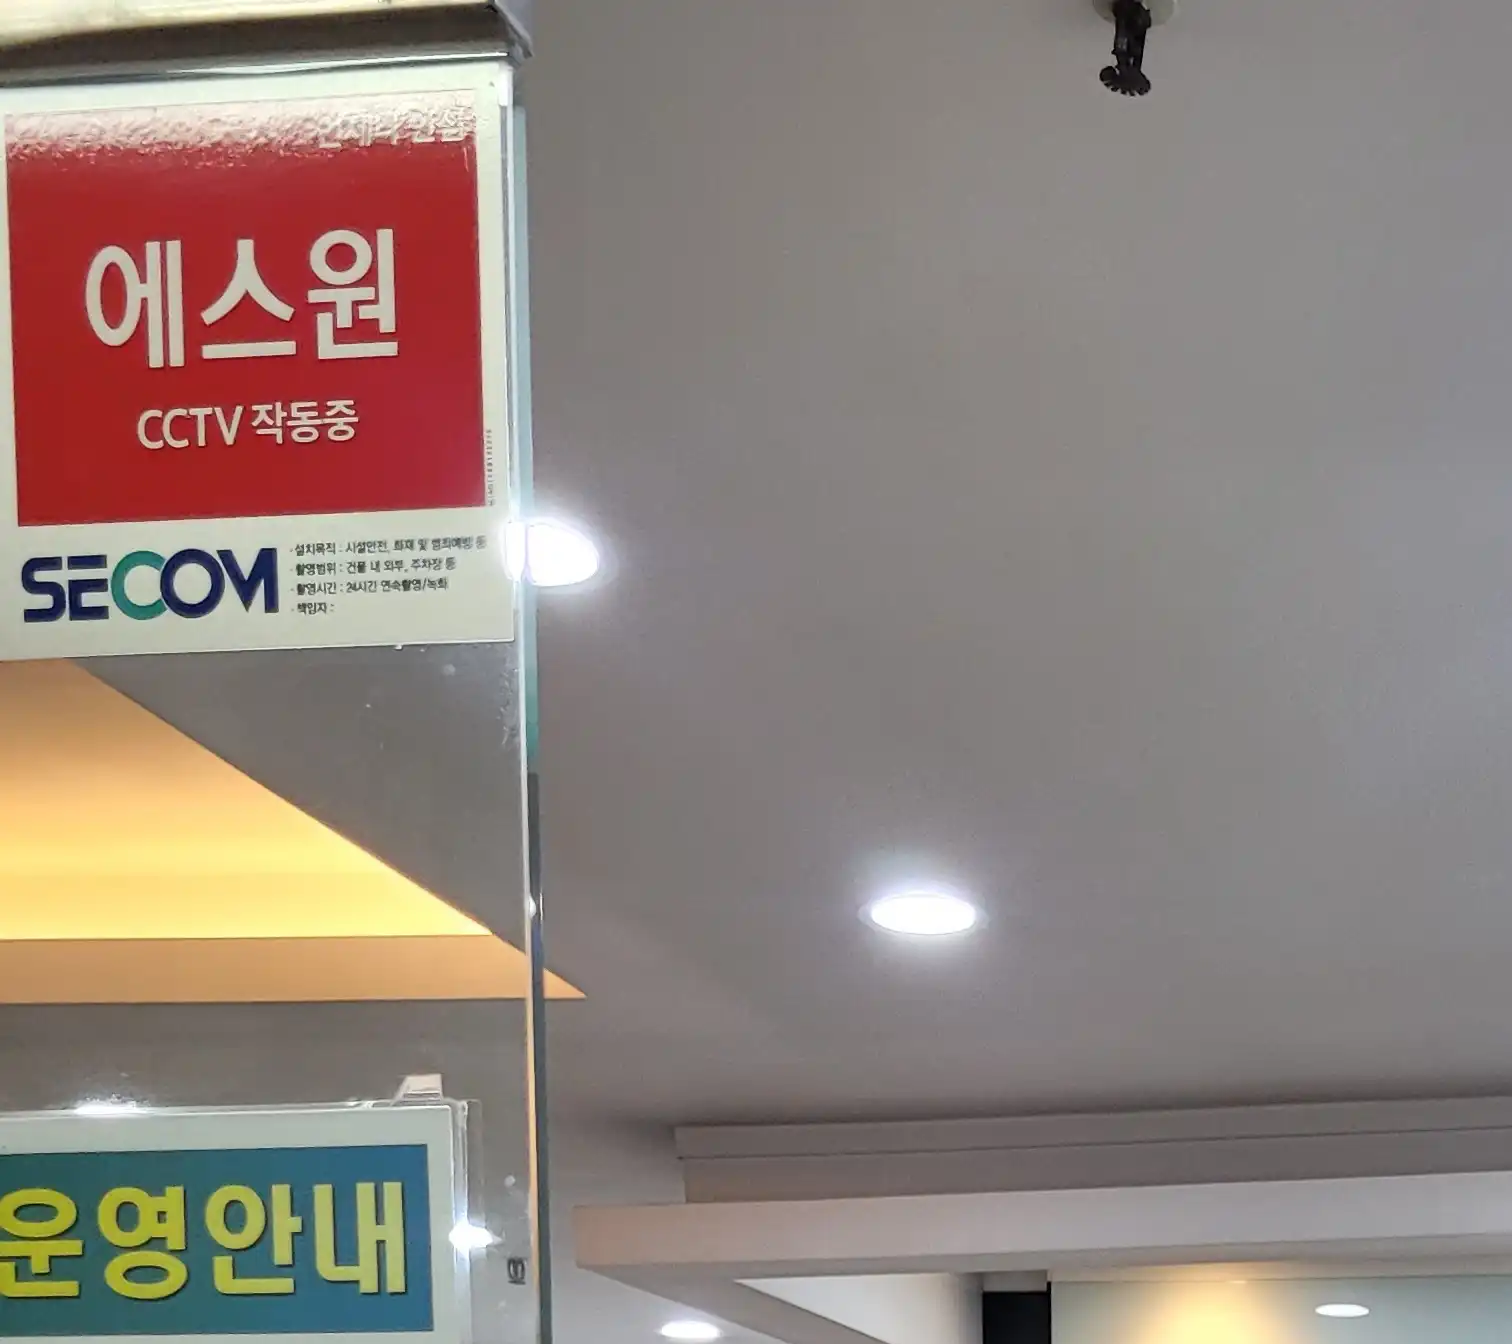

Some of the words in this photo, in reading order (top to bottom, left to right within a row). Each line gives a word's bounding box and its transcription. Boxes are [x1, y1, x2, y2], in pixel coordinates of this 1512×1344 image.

[85, 229, 399, 367] 에스원
[138, 405, 244, 449] CCTV
[250, 400, 359, 444] 작동중
[21, 548, 279, 622] SECOM
[0, 1181, 406, 1300] 운영안내
